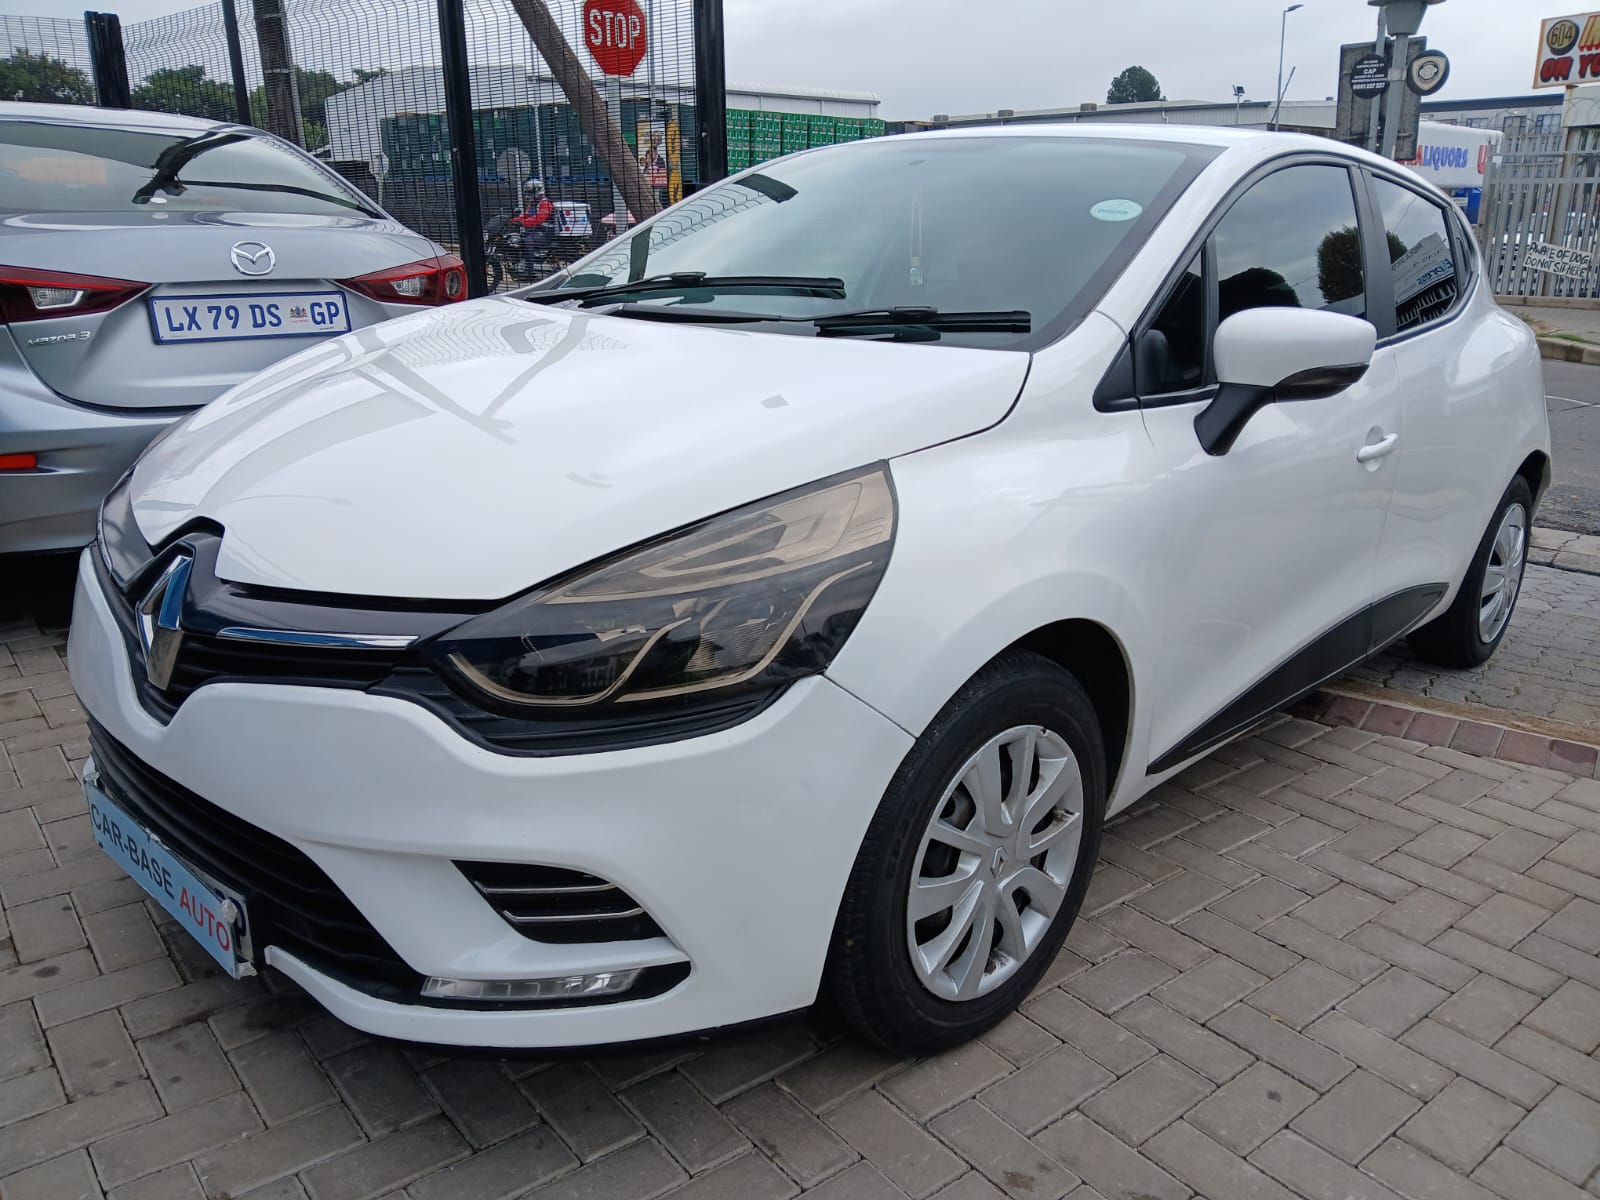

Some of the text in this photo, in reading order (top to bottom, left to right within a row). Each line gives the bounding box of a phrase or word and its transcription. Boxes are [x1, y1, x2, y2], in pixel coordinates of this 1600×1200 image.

[589, 9, 641, 49] STOP
[1550, 23, 1573, 46] 604
[1540, 55, 1574, 83] ON
[1423, 145, 1469, 171] LIQUORS
[1556, 249, 1571, 261] OF
[1553, 262, 1568, 273] SIT
[1566, 264, 1586, 278] HERE
[165, 301, 340, 332] LX 79 DS GP
[79, 330, 92, 341] 3
[90, 803, 231, 952] CAR-BASE AUTO
